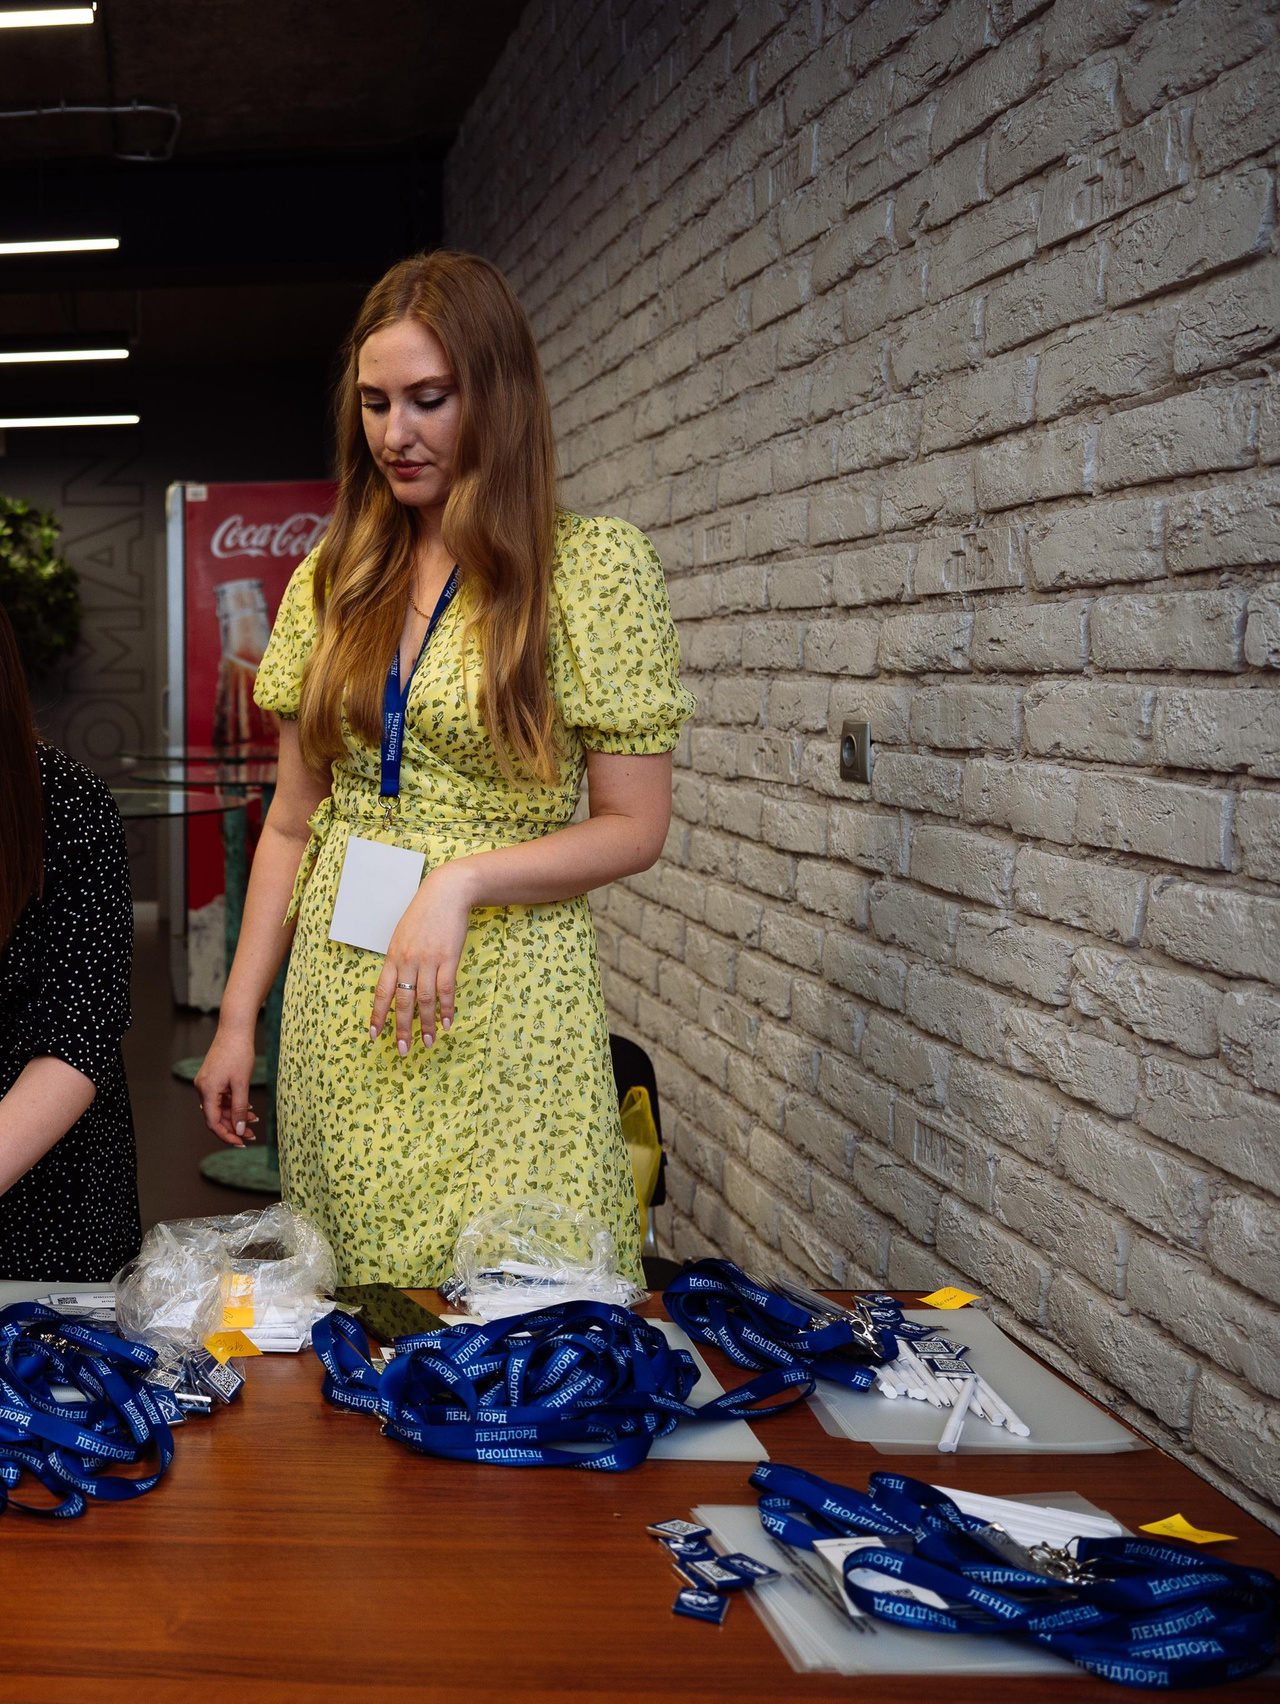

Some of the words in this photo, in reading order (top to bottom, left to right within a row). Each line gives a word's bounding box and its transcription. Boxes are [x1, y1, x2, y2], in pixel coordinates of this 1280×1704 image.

[63, 434, 145, 855] OMAN
[386, 712, 400, 762] ЛЕНДЛОРД
[742, 1326, 794, 1366] ЛЕНДЛОРД
[30, 1394, 88, 1420] ЛЕНДЛОРД
[123, 1399, 150, 1441] ЛЕНДЛОРД
[138, 1386, 161, 1425] ЛЕНДЛОРД
[75, 1435, 136, 1461] ЛЕНДЛОРД
[475, 1428, 537, 1442] ЛЕНДЛОРД
[476, 1447, 543, 1460] ЛЕНДЛОРД
[874, 1597, 958, 1630] ЛЕНДЛОРД
[1131, 1606, 1217, 1641] ЛЕНДЛОРД
